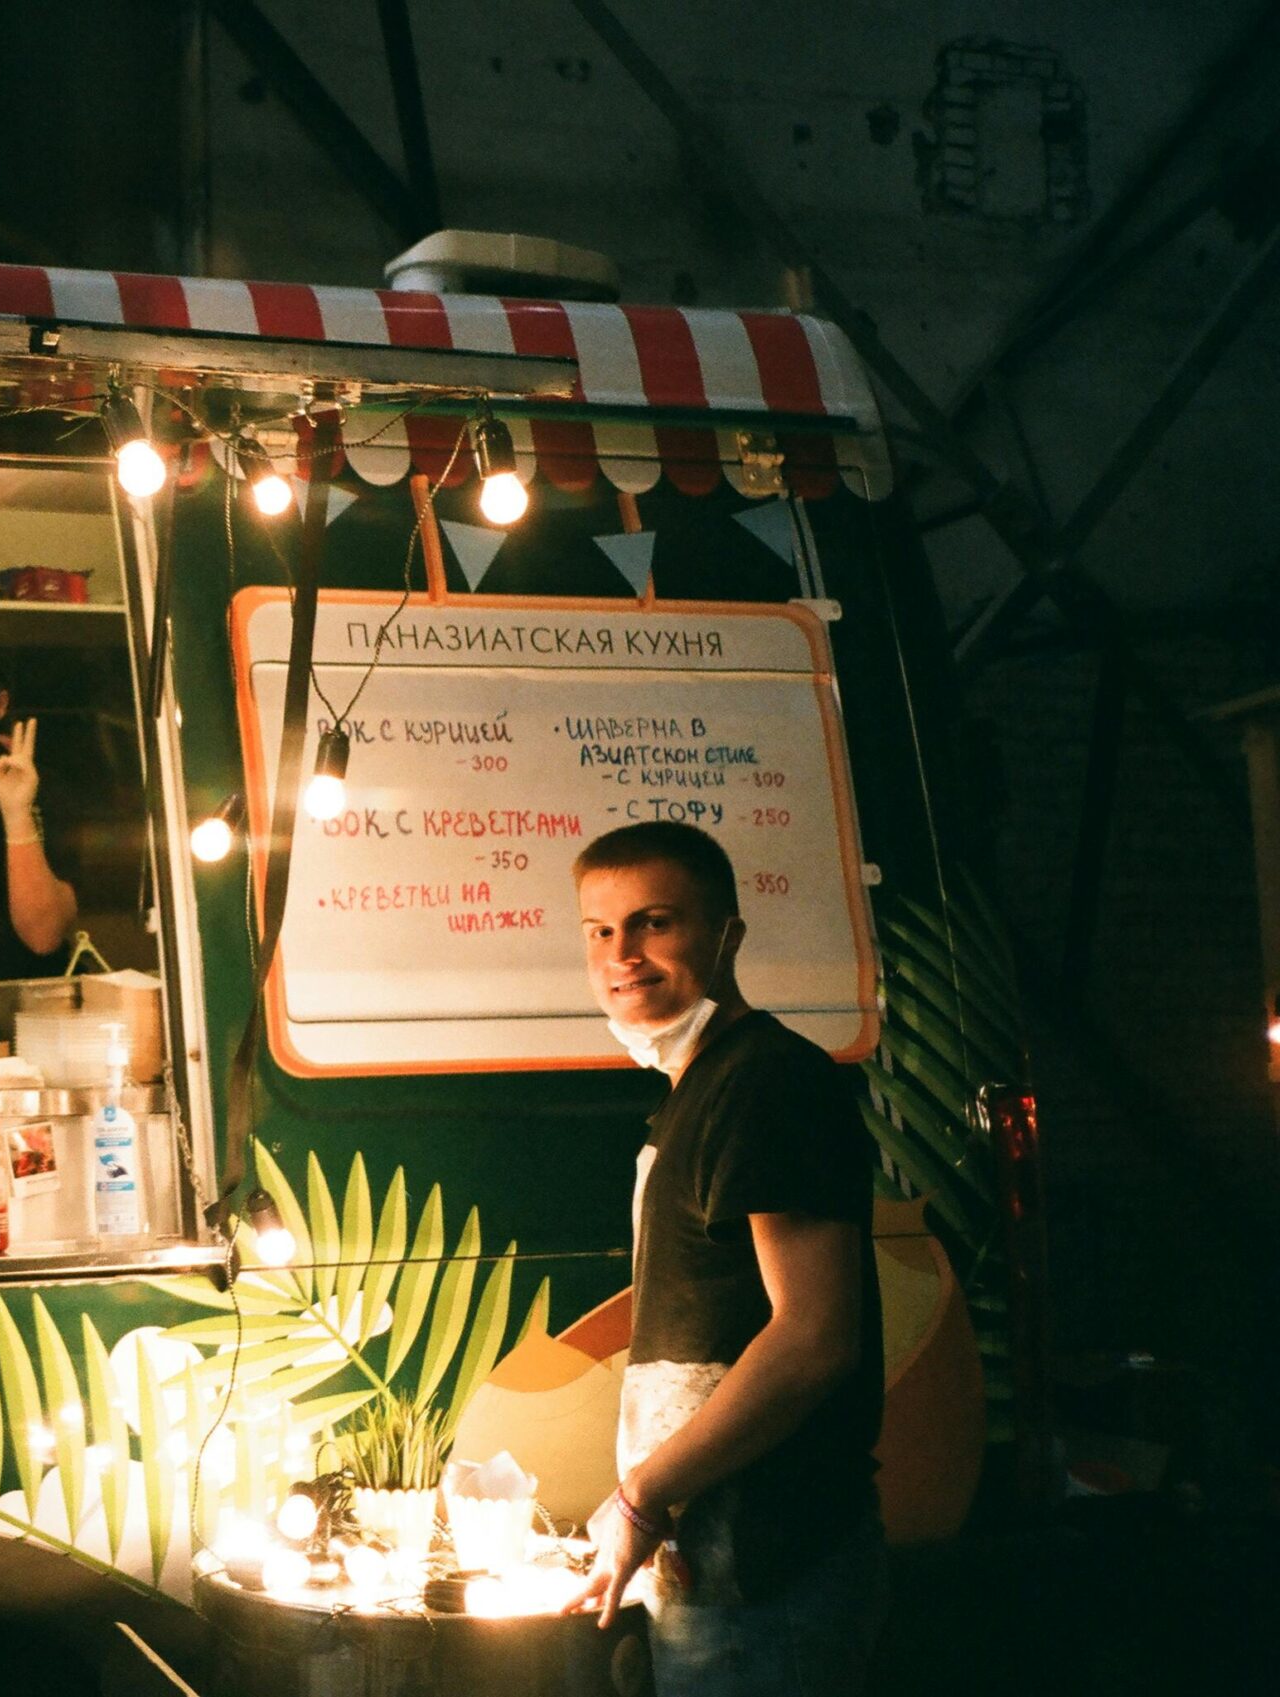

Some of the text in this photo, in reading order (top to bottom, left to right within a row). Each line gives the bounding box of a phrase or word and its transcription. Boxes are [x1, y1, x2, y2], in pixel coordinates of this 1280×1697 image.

[346, 621, 723, 657] ПАНАЗИАТСКАЯ КУХНЯ
[405, 710, 513, 745] КУРИЦЕЙ
[690, 717, 707, 739] В
[704, 745, 761, 765] СТИЛЕ
[395, 809, 413, 835] С
[423, 808, 583, 839] КРЕВЕТКАМИ
[648, 798, 725, 824] ТОФУ
[330, 880, 491, 911] КРЕВЕТКИ НА
[447, 906, 546, 934] ШПАЖКЕ
